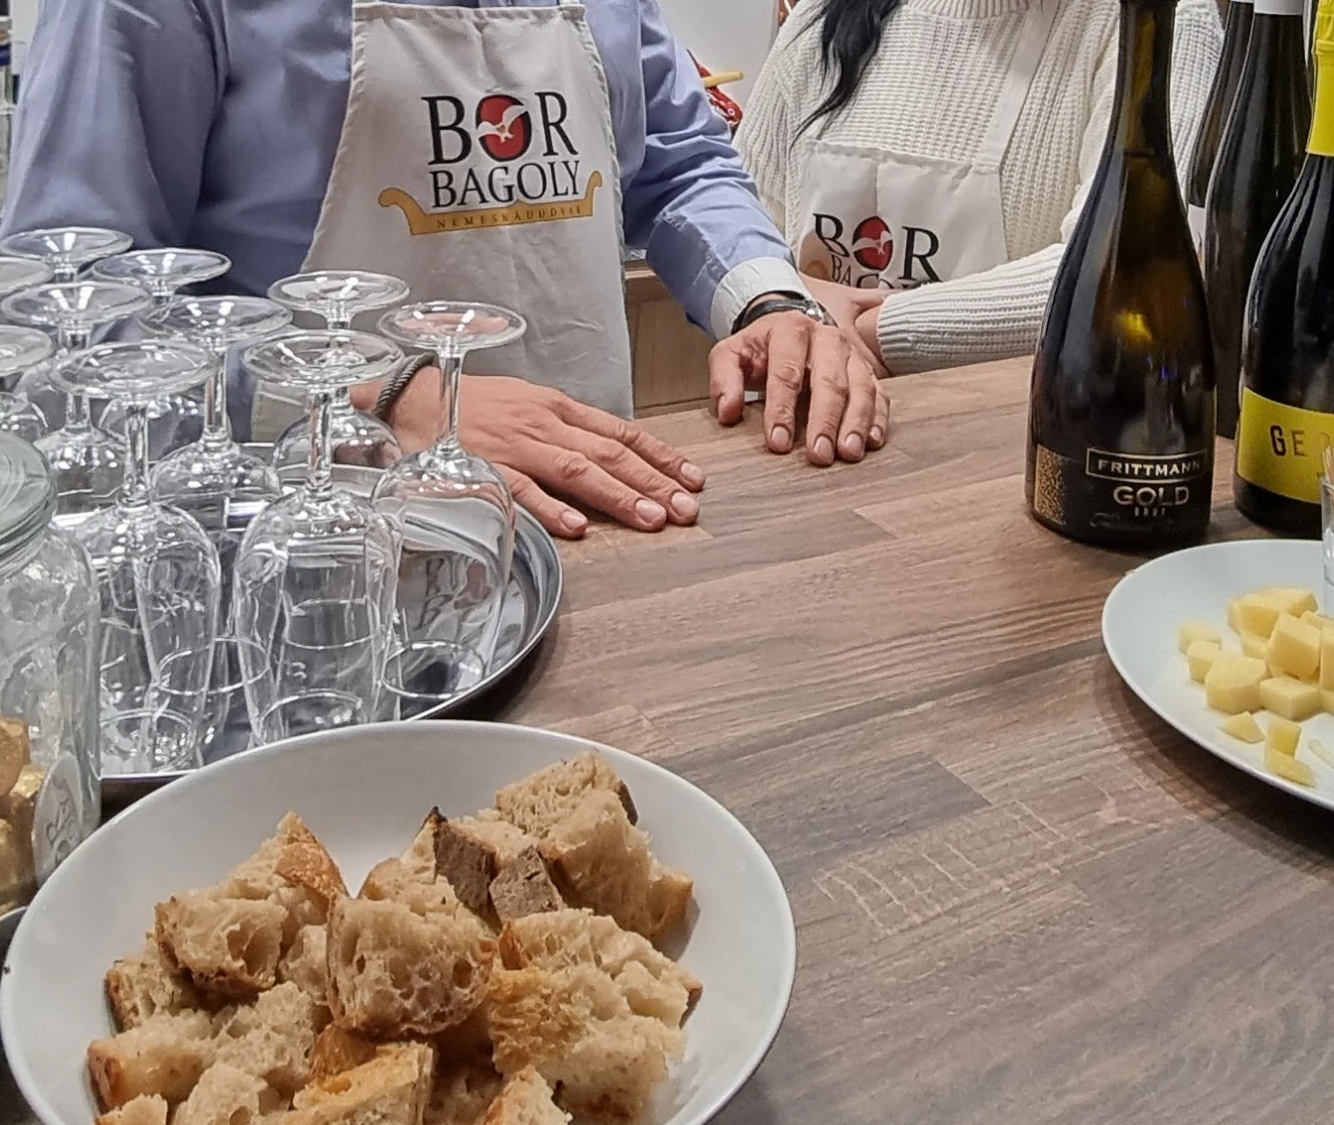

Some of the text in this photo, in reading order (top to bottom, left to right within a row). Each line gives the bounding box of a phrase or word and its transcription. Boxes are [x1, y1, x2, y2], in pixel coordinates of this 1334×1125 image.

[421, 91, 578, 165] BOR
[430, 161, 580, 208] BAGOLY
[813, 213, 943, 283] BOR
[1098, 459, 1201, 477] FRITTMANN
[1113, 485, 1190, 507] GOLD
